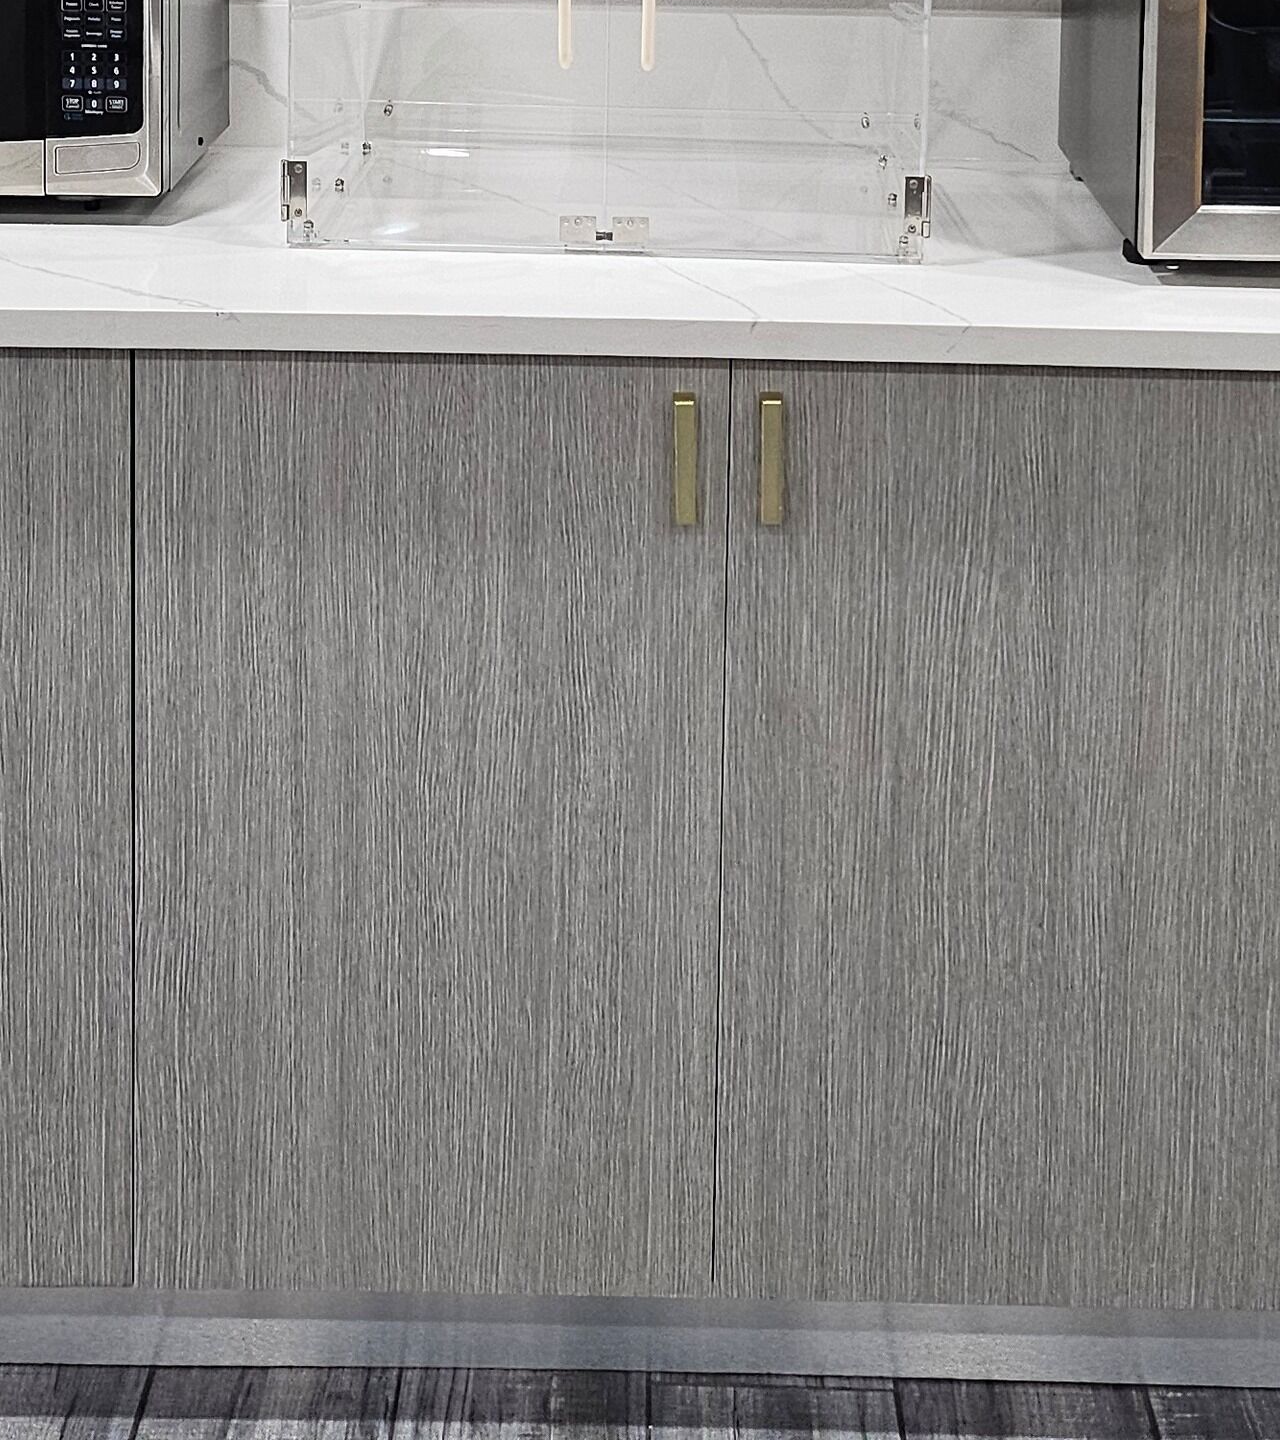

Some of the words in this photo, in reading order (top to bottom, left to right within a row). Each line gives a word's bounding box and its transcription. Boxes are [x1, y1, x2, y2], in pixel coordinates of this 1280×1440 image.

[70, 52, 75, 61] 1
[91, 52, 97, 61] 2
[114, 53, 120, 62] 3
[69, 65, 75, 74] 4
[91, 65, 98, 75] 5
[113, 66, 120, 75] 6
[69, 79, 76, 88] 7
[91, 79, 98, 88] 8
[113, 80, 120, 89] 9
[91, 99, 98, 109] 0
